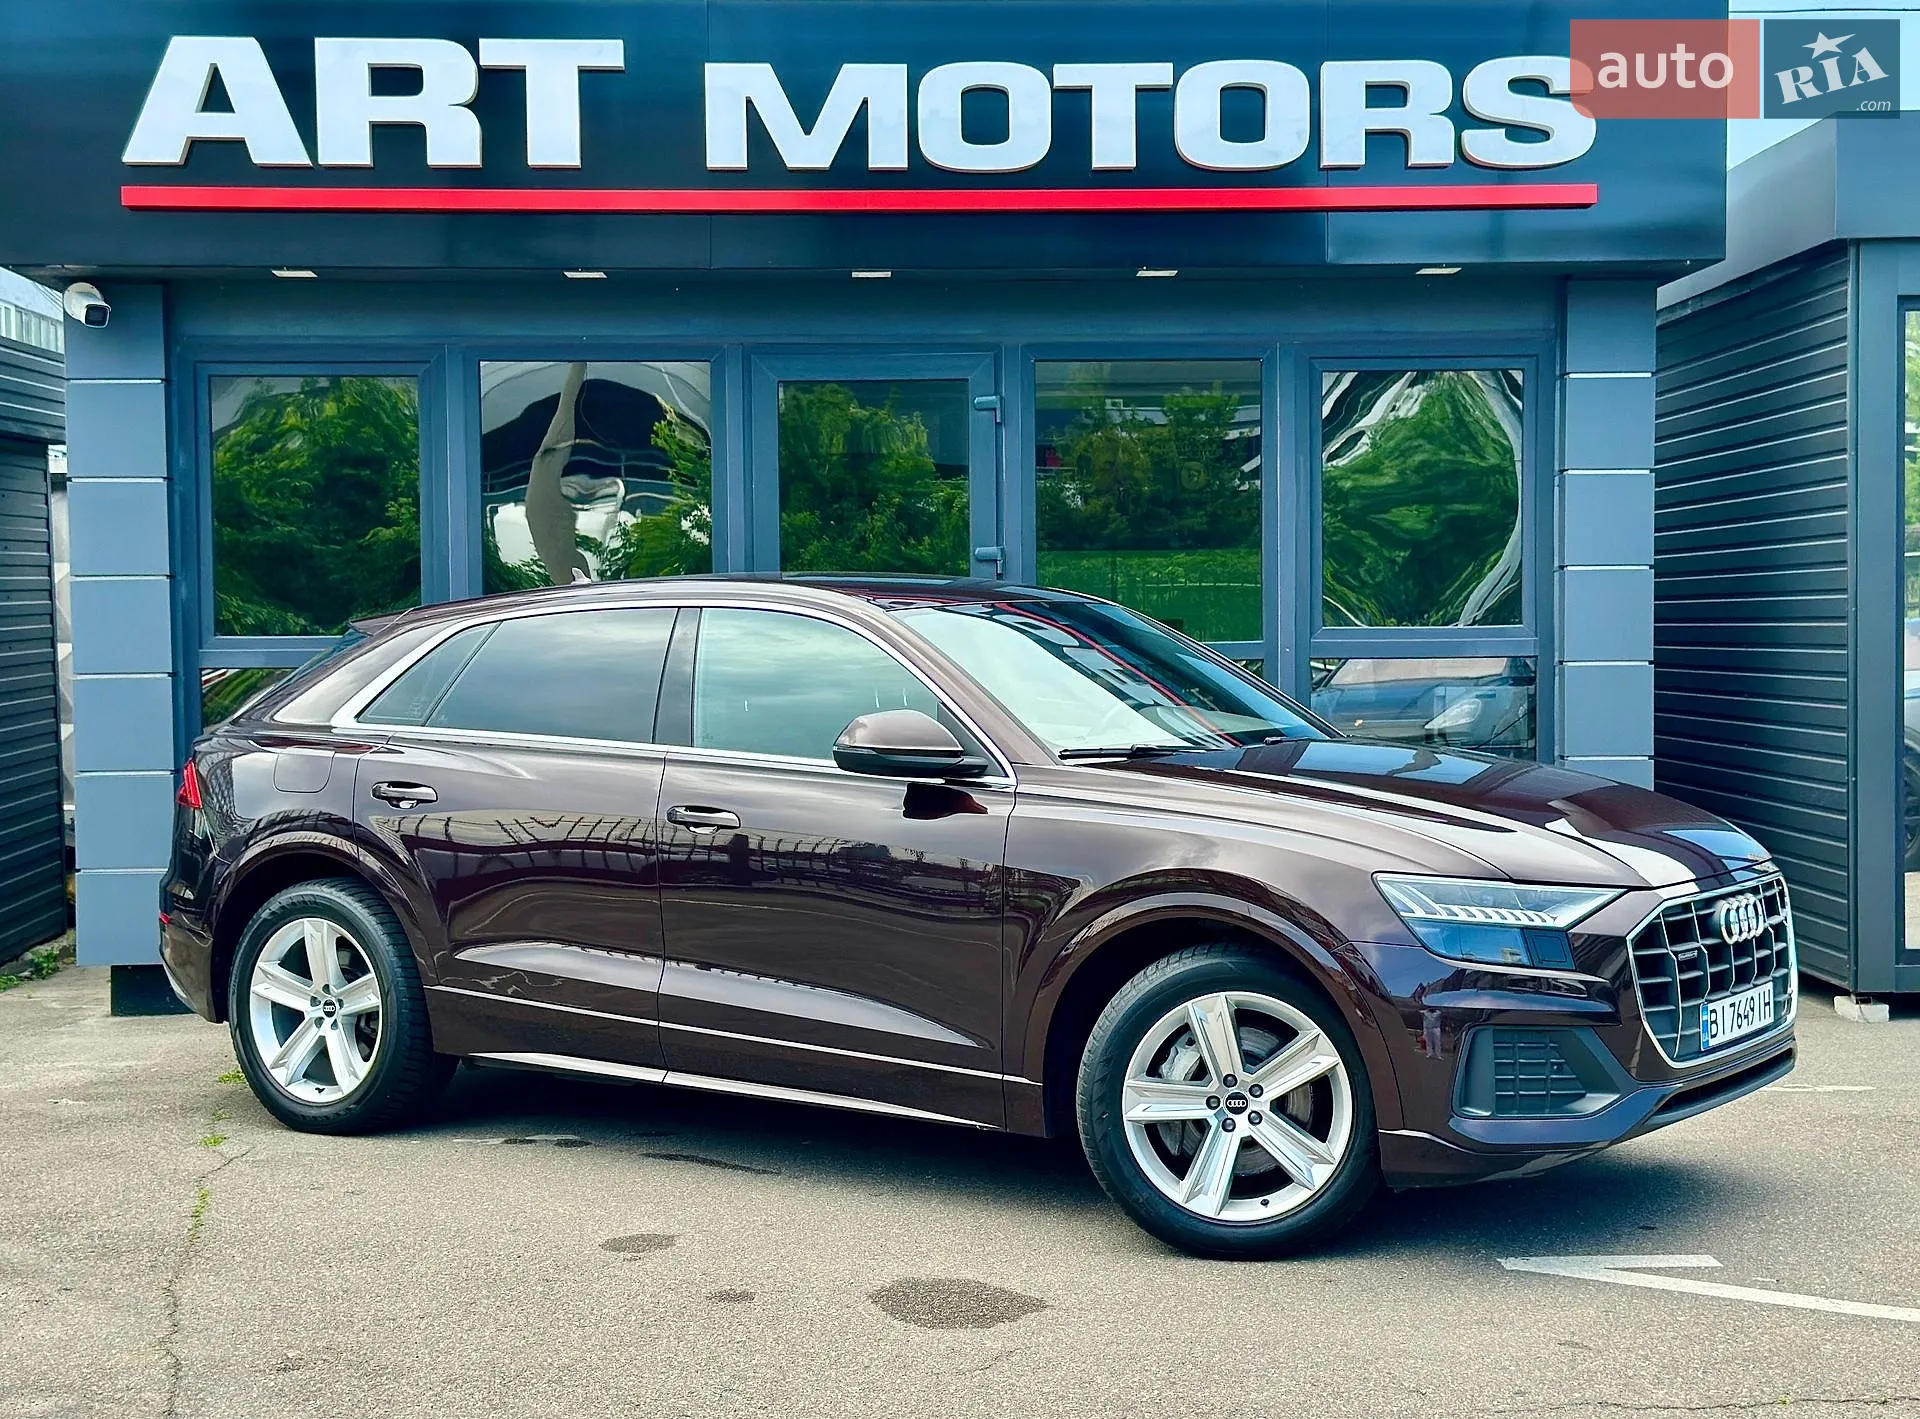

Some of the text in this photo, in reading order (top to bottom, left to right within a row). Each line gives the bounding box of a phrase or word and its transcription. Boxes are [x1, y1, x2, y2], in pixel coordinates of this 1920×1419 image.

[122, 36, 1597, 171] ART MOTORS
[1729, 995, 1755, 1033] 7649
